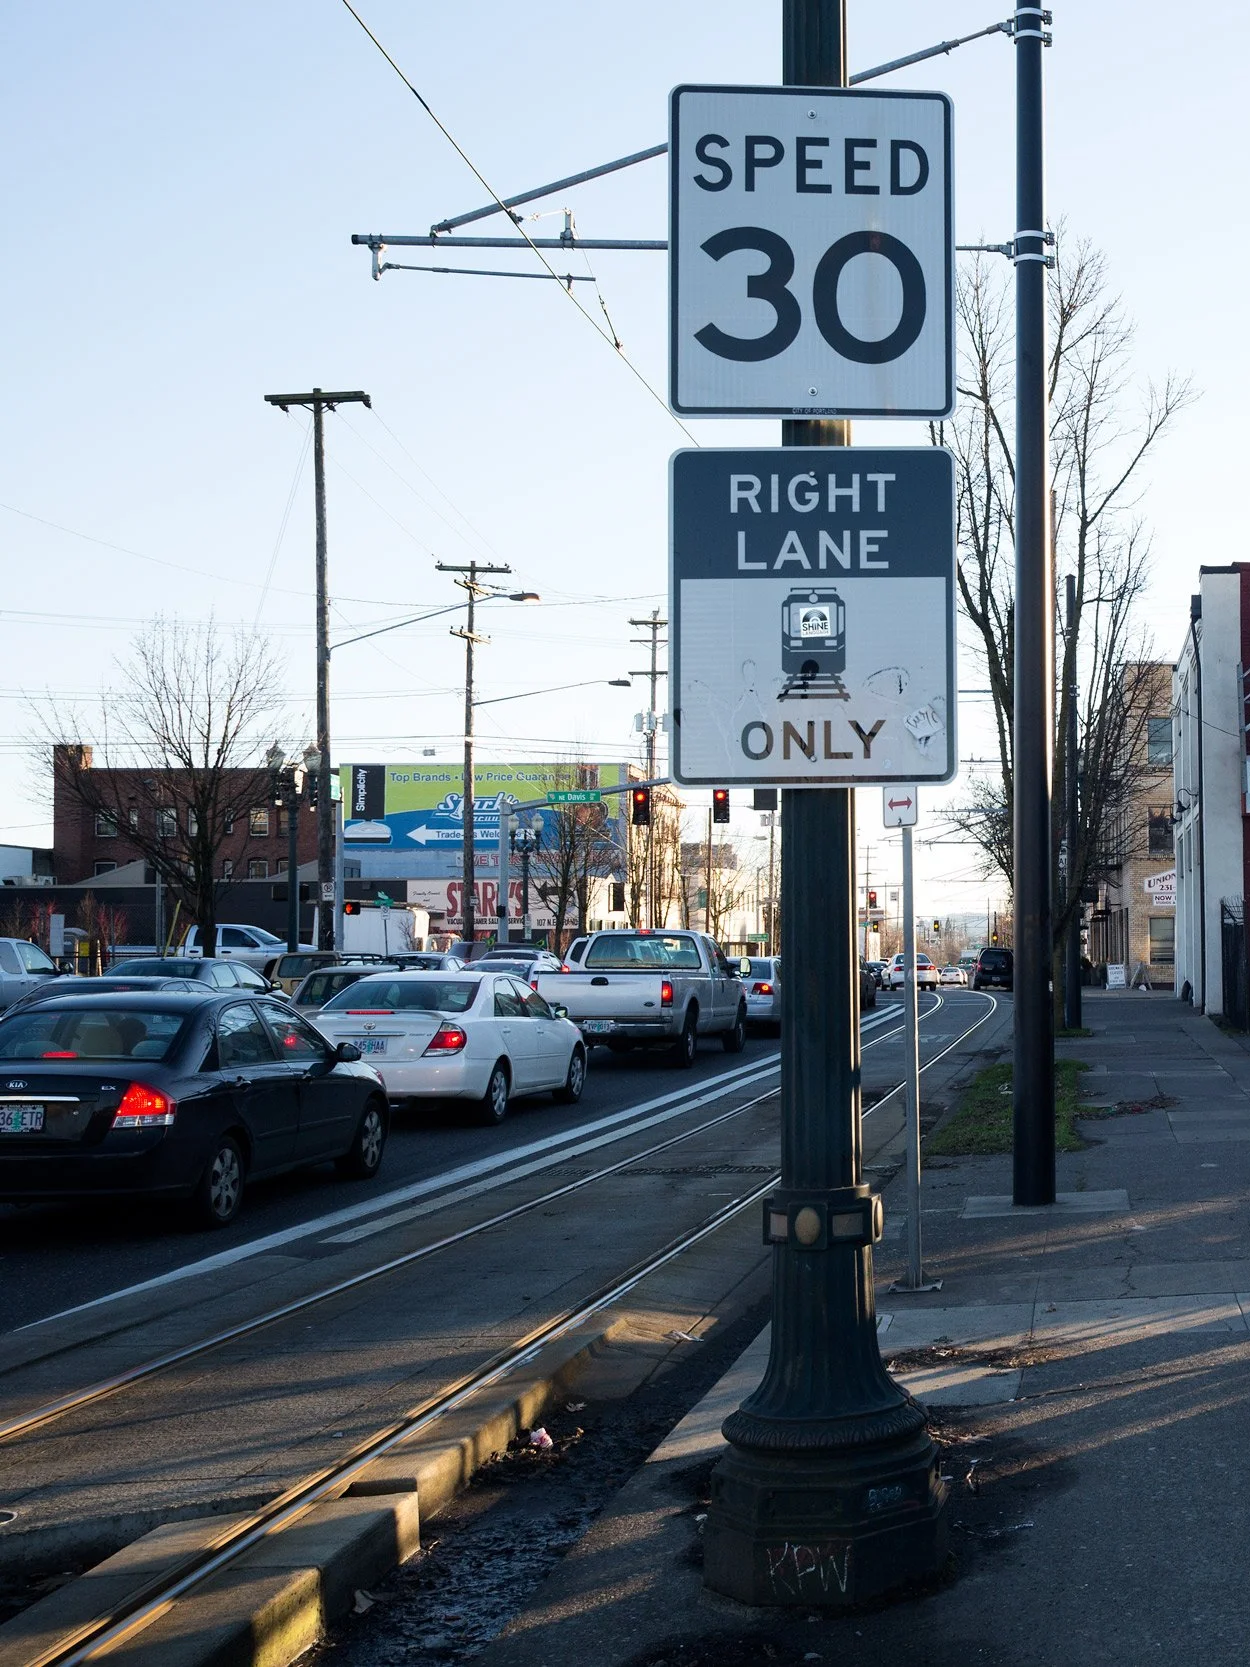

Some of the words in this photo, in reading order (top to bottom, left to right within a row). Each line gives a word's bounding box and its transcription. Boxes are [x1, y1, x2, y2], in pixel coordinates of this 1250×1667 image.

[693, 133, 929, 195] SPEED
[693, 226, 927, 365] 30
[730, 473, 896, 514] RIGHT
[737, 530, 889, 570] LANE
[802, 622, 829, 631] SHINE
[740, 719, 887, 761] ONLY
[390, 772, 410, 782] Top
[413, 772, 451, 781] Brands
[461, 772, 483, 781] Lw
[486, 772, 513, 781] Price
[355, 768, 368, 812] Simplicity
[567, 792, 586, 801] Davis
[436, 830, 477, 839] Trade-s
[447, 881, 524, 918] STR'S
[447, 917, 464, 925] VACUU
[536, 918, 546, 926] 107
[8, 1080, 24, 1088] KIA
[20, 1111, 43, 1126] ETR
